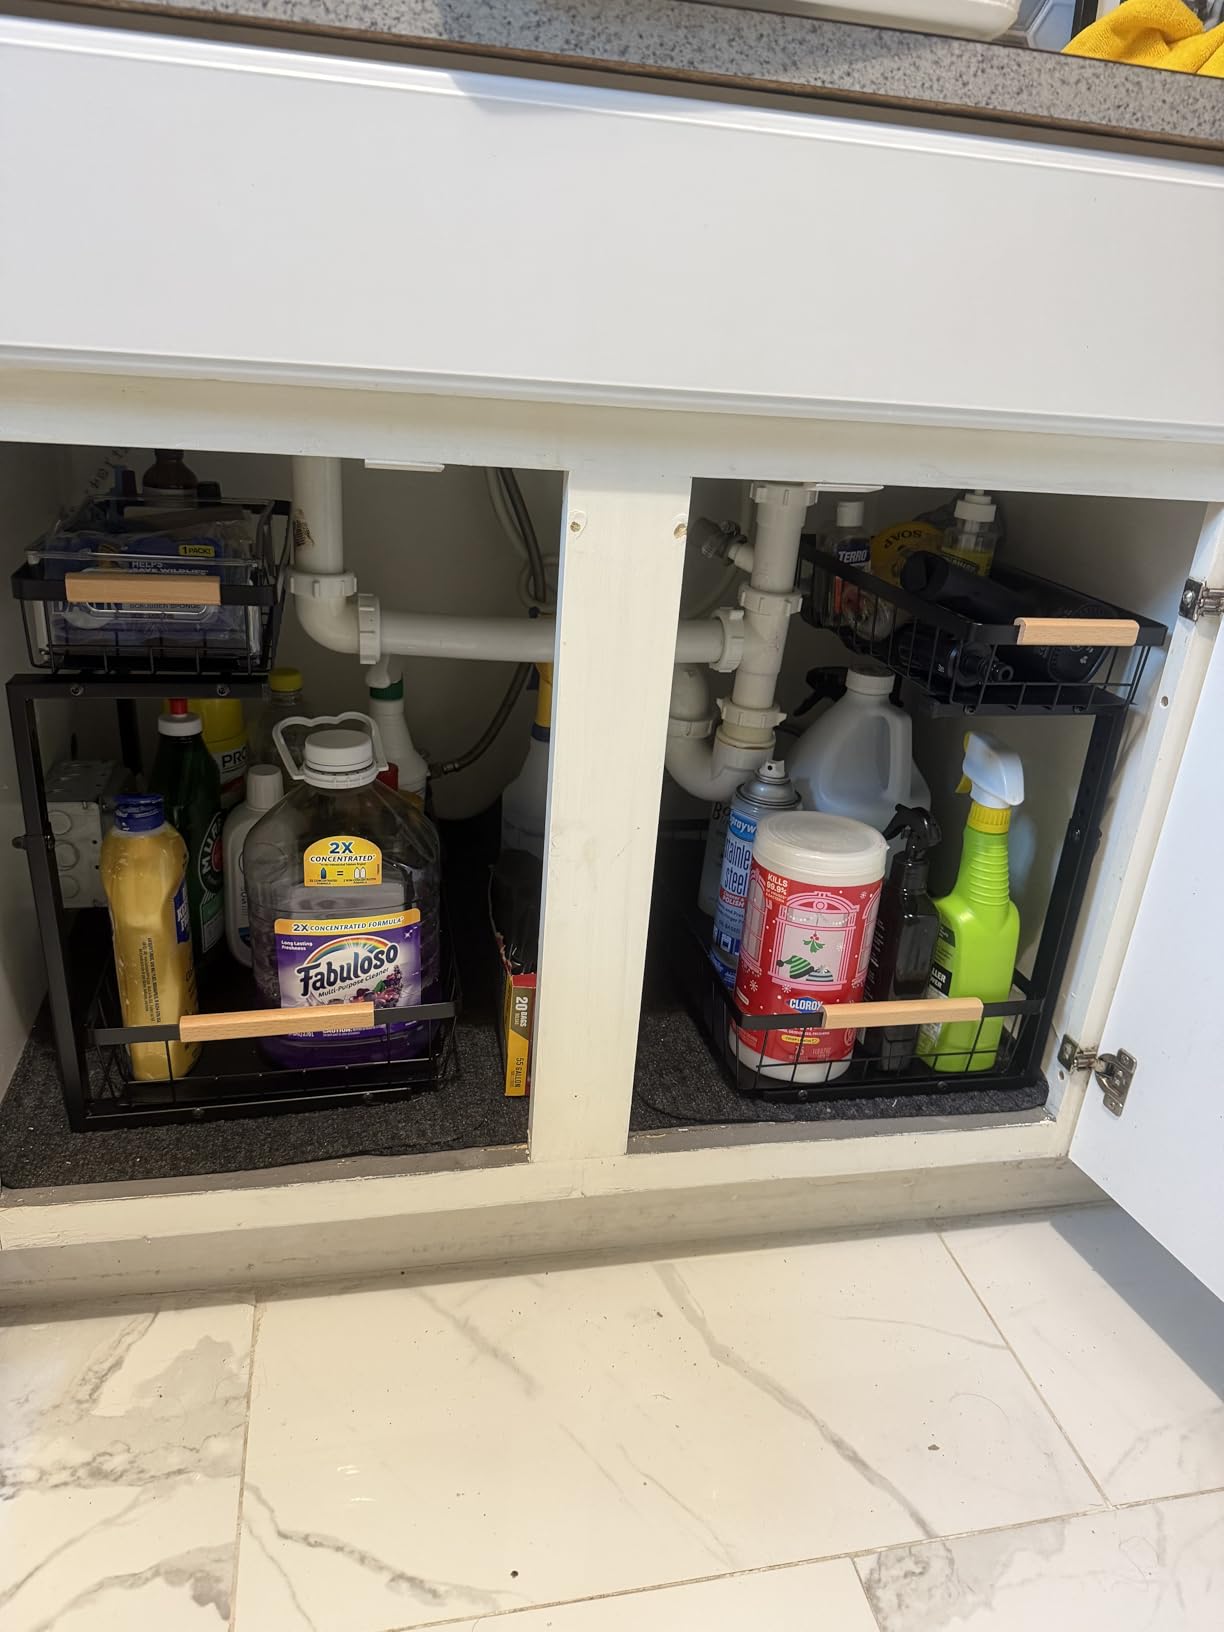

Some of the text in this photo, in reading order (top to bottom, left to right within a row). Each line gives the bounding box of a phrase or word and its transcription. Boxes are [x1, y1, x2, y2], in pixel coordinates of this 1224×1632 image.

[884, 529, 922, 549] SOAP
[838, 549, 868, 564] TERRO
[330, 842, 354, 854] 2X
[725, 867, 748, 896] steel
[768, 873, 788, 888] KILLS
[766, 881, 787, 896] 99.9%
[722, 897, 745, 908] POLISH
[294, 924, 309, 932] 2X
[310, 923, 366, 932] CONCENTRATED
[297, 944, 398, 997] Fabuloso
[318, 968, 390, 998] Multi-Purpose Cleaner
[516, 996, 528, 1028] 20 BAGS
[790, 999, 823, 1010] CLOROX
[514, 1066, 522, 1088] GALLON
